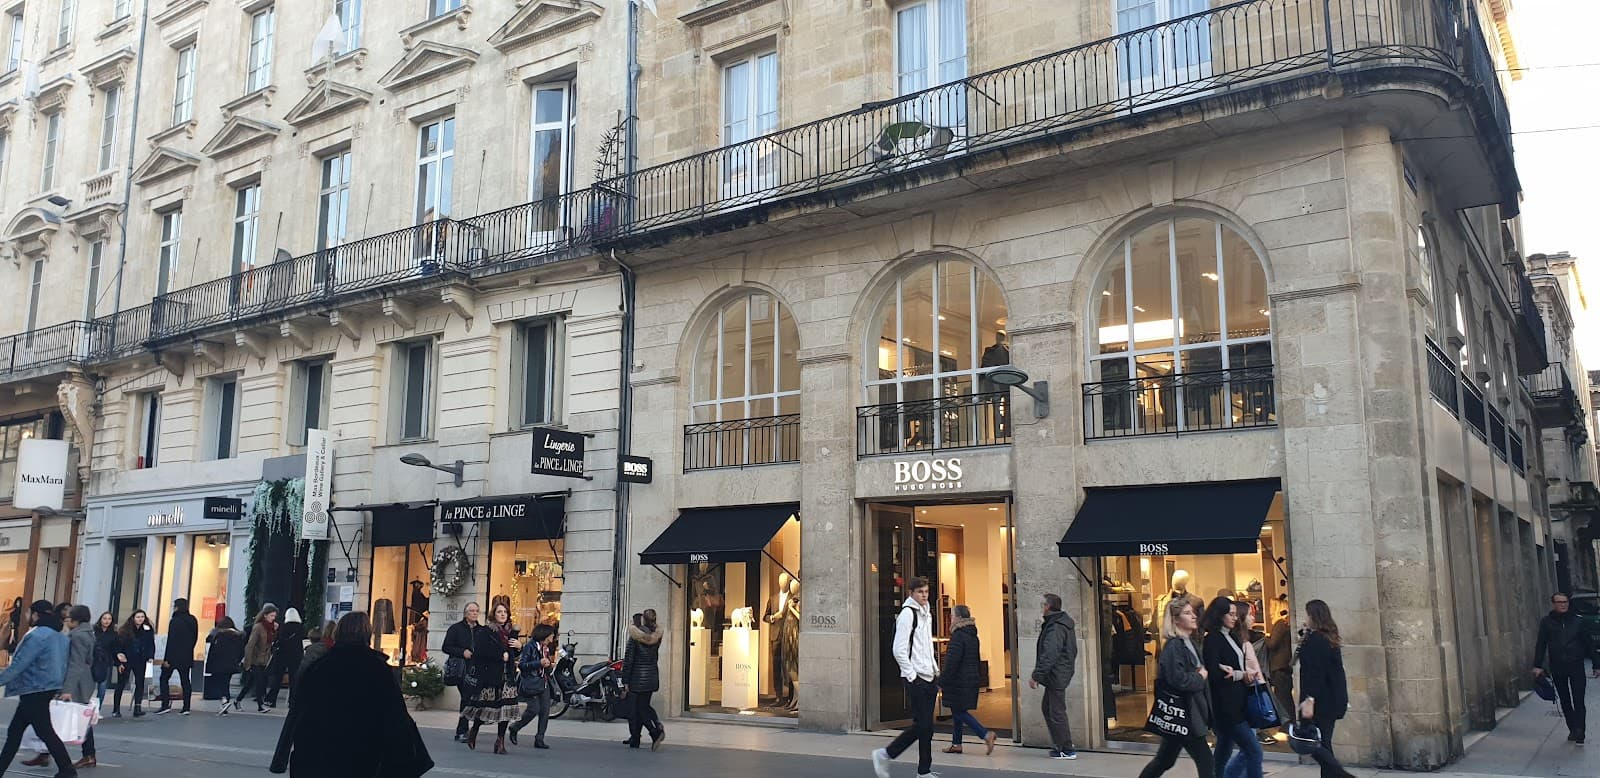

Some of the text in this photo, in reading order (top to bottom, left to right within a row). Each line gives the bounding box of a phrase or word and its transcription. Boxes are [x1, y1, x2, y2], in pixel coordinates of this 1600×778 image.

[544, 434, 575, 454] Lingerie
[540, 457, 559, 470] PINCE
[563, 459, 583, 473] LINGE
[624, 462, 647, 473] BOSS
[894, 458, 963, 483] BOSS
[21, 474, 63, 485] MaxMara
[895, 481, 962, 491] HUGO BOSS
[148, 505, 184, 526] minelli
[211, 505, 237, 513] minelli
[445, 504, 525, 519] la PINCE à LINGE
[1139, 543, 1168, 553] BOSS
[811, 615, 836, 625] BOSS
[1157, 699, 1186, 718] TASTE
[1149, 714, 1189, 735] LIBERTAD
